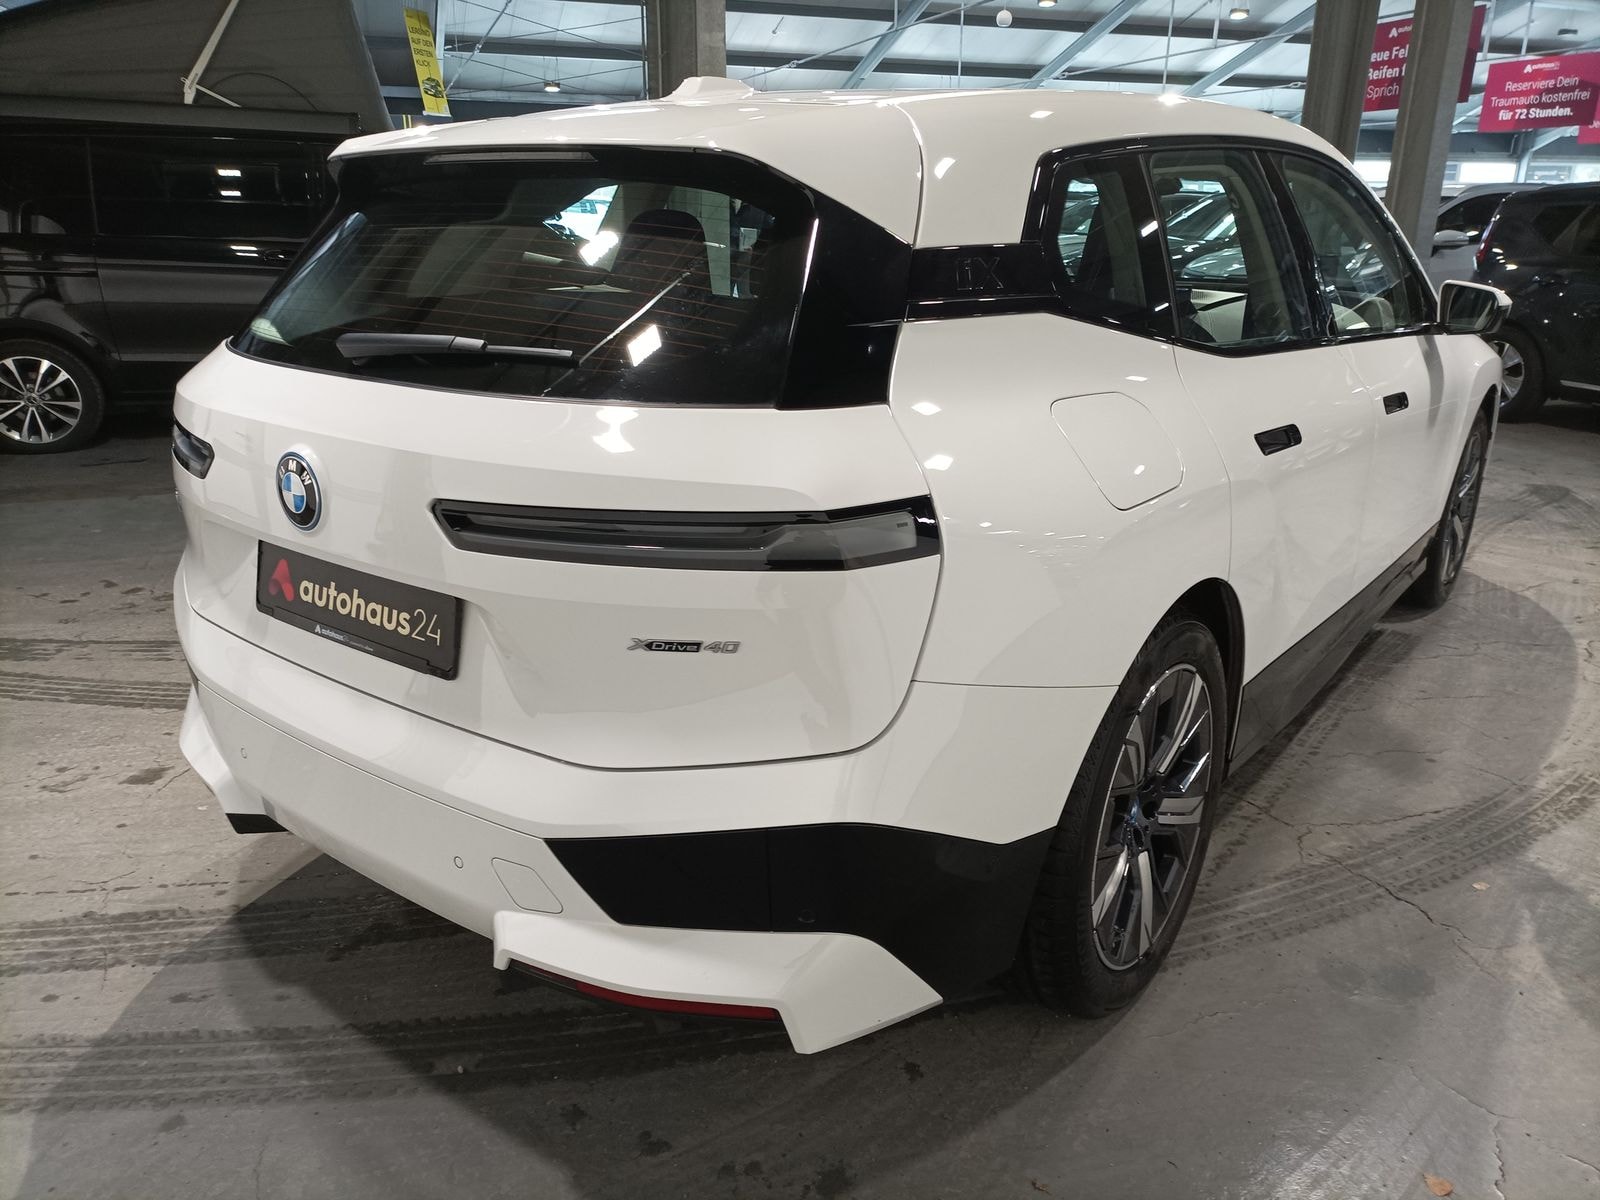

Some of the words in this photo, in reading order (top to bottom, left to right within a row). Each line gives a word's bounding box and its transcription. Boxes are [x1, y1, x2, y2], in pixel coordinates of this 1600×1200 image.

[1371, 51, 1390, 62] eue
[1391, 44, 1409, 59] Fel
[1367, 83, 1399, 100] Sprich
[1504, 79, 1555, 92] Reserviere
[1556, 76, 1579, 88] Dein
[1490, 95, 1540, 107] Traumauto
[1541, 88, 1591, 103] kostenfrei
[1498, 108, 1513, 121] für
[1514, 109, 1527, 119] 72
[1528, 106, 1574, 118] Stunden.
[279, 459, 313, 486] BMW
[299, 579, 441, 646] autohaus24
[703, 640, 742, 654] 40
